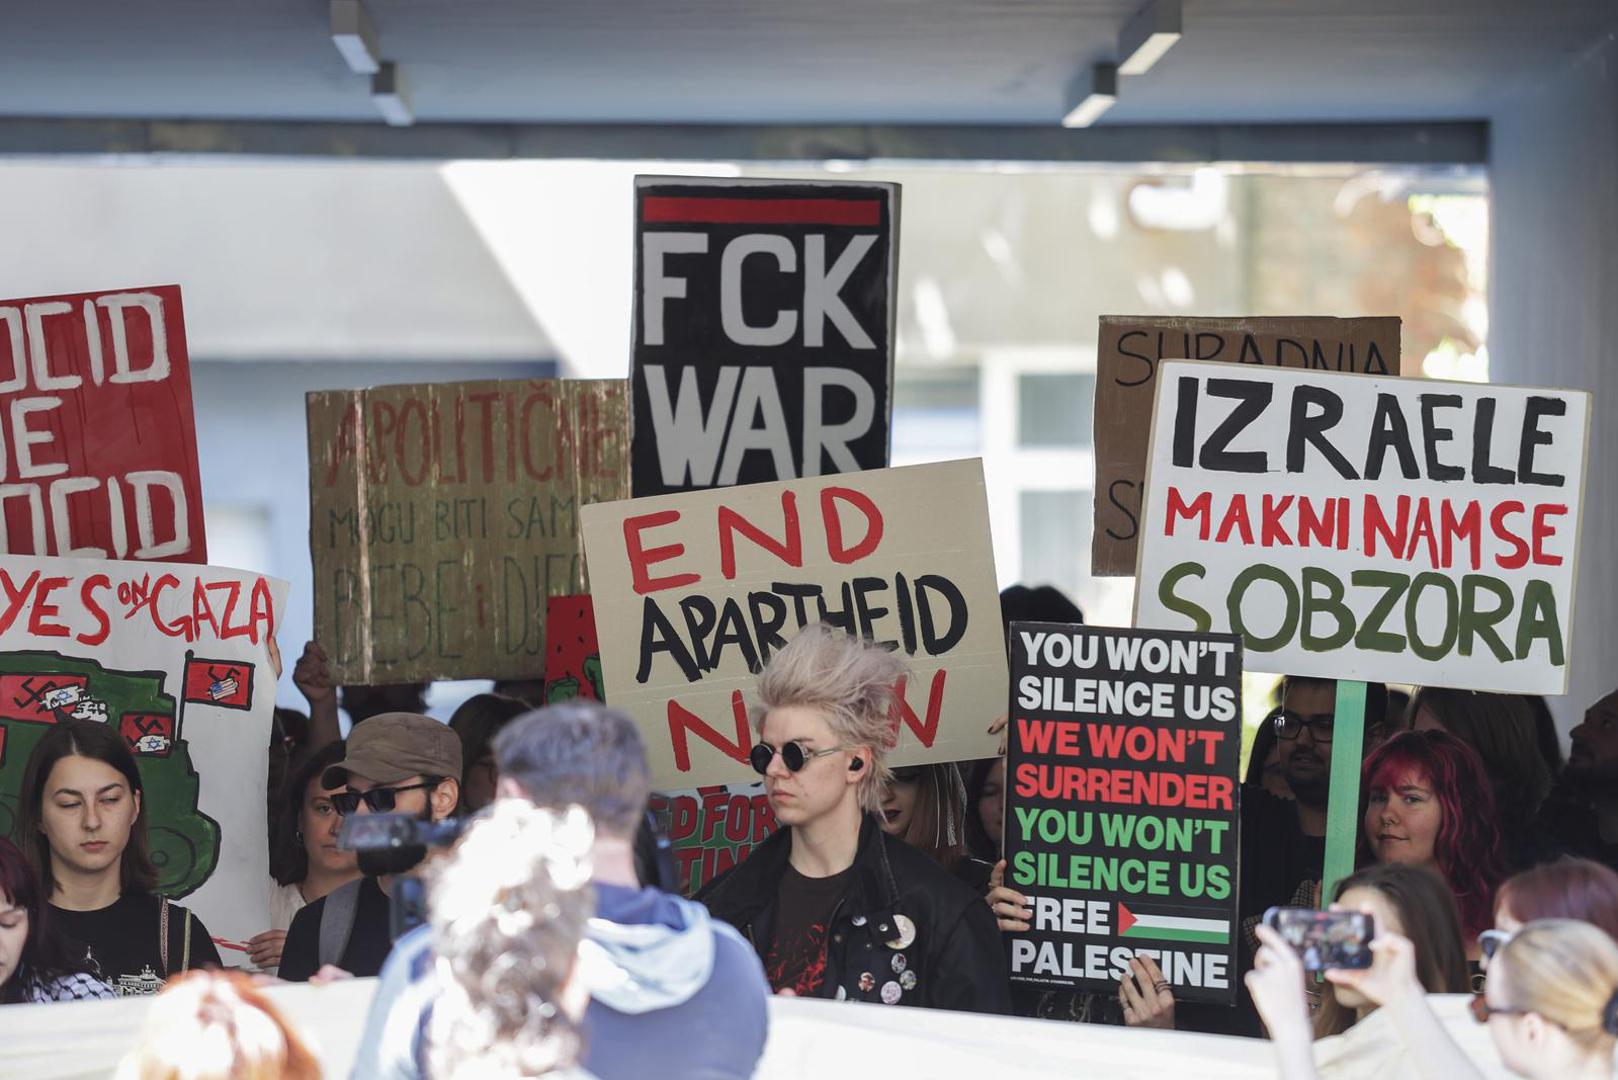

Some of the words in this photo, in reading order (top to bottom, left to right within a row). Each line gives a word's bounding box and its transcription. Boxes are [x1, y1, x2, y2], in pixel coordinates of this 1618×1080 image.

[642, 231, 879, 349] FCK
[0, 396, 70, 479] E
[325, 382, 618, 486] APOLITIČNE
[642, 364, 876, 486] WAR
[1172, 376, 1567, 487] IZRAELE
[435, 497, 487, 542] BITI
[507, 493, 601, 540] SAM
[623, 486, 884, 595] END
[1164, 486, 1352, 551] MAKNI
[1363, 494, 1482, 570] NAM
[1488, 500, 1568, 570] SE
[149, 573, 275, 646] GAZA
[636, 571, 969, 683] APARTHEID
[1226, 563, 1566, 667] OBZORA
[1019, 632, 1099, 669] YOU
[1104, 636, 1235, 677] WON'T
[666, 668, 947, 773] NW
[1017, 675, 1176, 718] SILENCE
[1183, 685, 1237, 722] US
[1016, 719, 1082, 757] WE
[1086, 723, 1225, 765] WON'T
[701, 792, 779, 843] FOR
[1014, 764, 1233, 811] SURRENDER
[1014, 807, 1093, 845] YOU
[1100, 812, 1230, 855] WON'T
[1013, 851, 1171, 896] SILENCE
[1179, 864, 1232, 901] US
